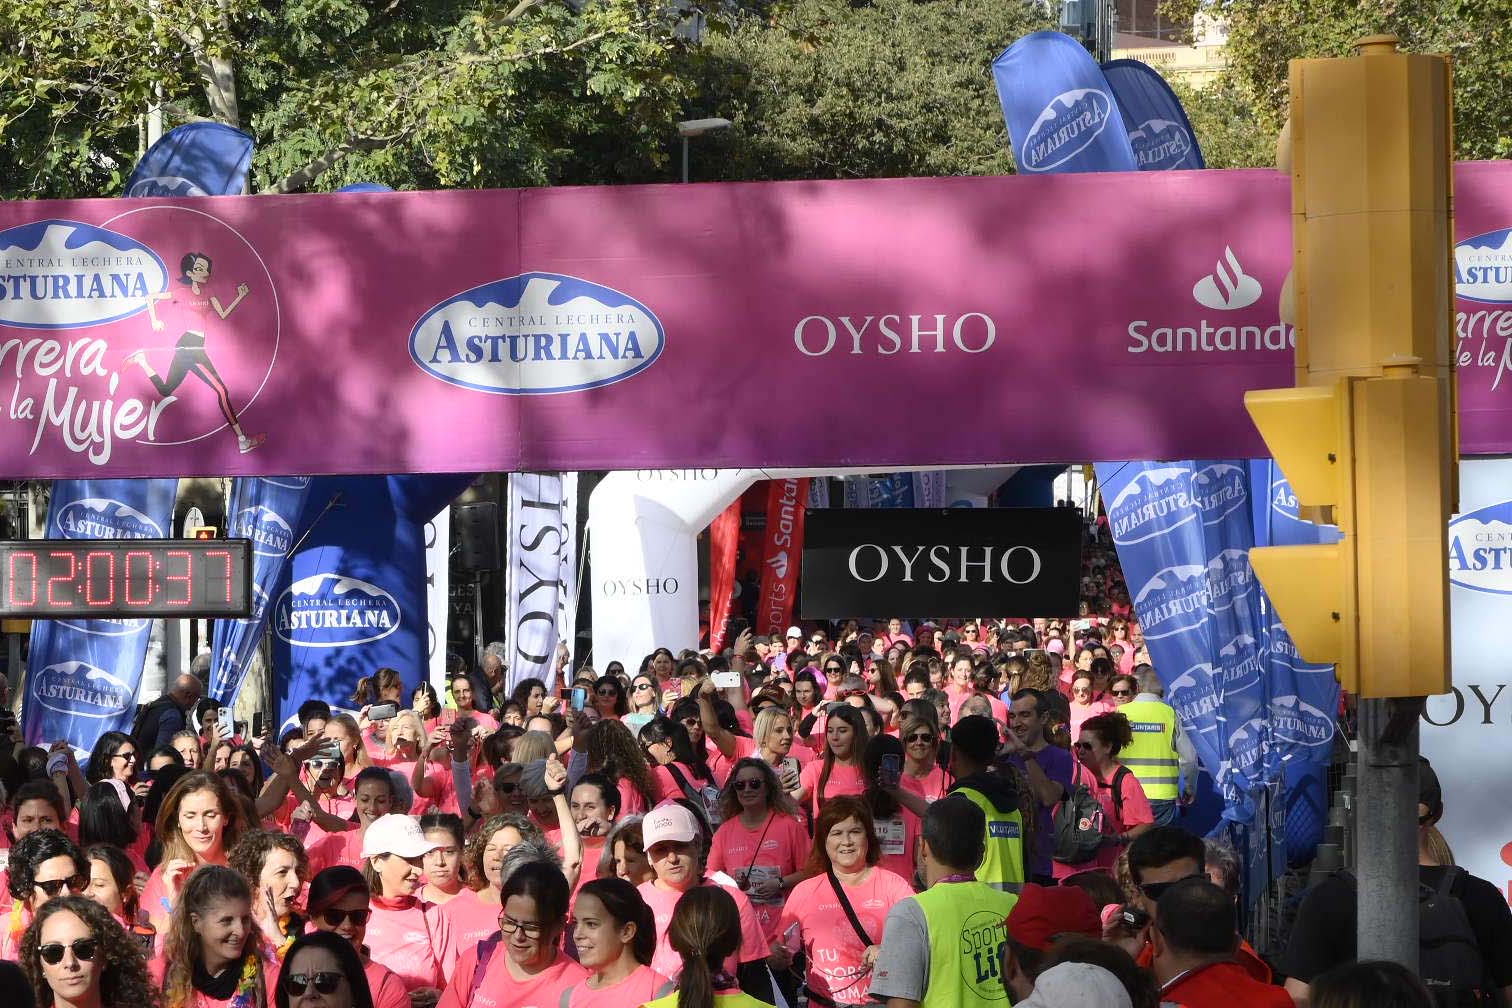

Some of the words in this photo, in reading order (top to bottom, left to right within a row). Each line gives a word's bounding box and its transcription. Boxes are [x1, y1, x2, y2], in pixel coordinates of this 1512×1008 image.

[71, 255, 143, 267] LECHERA
[469, 314, 547, 328] CENTRAL
[555, 313, 636, 326] LECHERA
[794, 312, 996, 356] OYSHO
[429, 320, 645, 363] ASTURIANA
[9, 381, 34, 420] la
[30, 372, 177, 465] Mujer
[10, 552, 233, 607] 02:00:37
[848, 544, 1042, 584] OYSHO
[602, 577, 679, 597] OYSHO
[277, 603, 392, 630] ASTURIANA
[38, 677, 125, 709] ASTURIANA
[817, 949, 838, 963] TU
